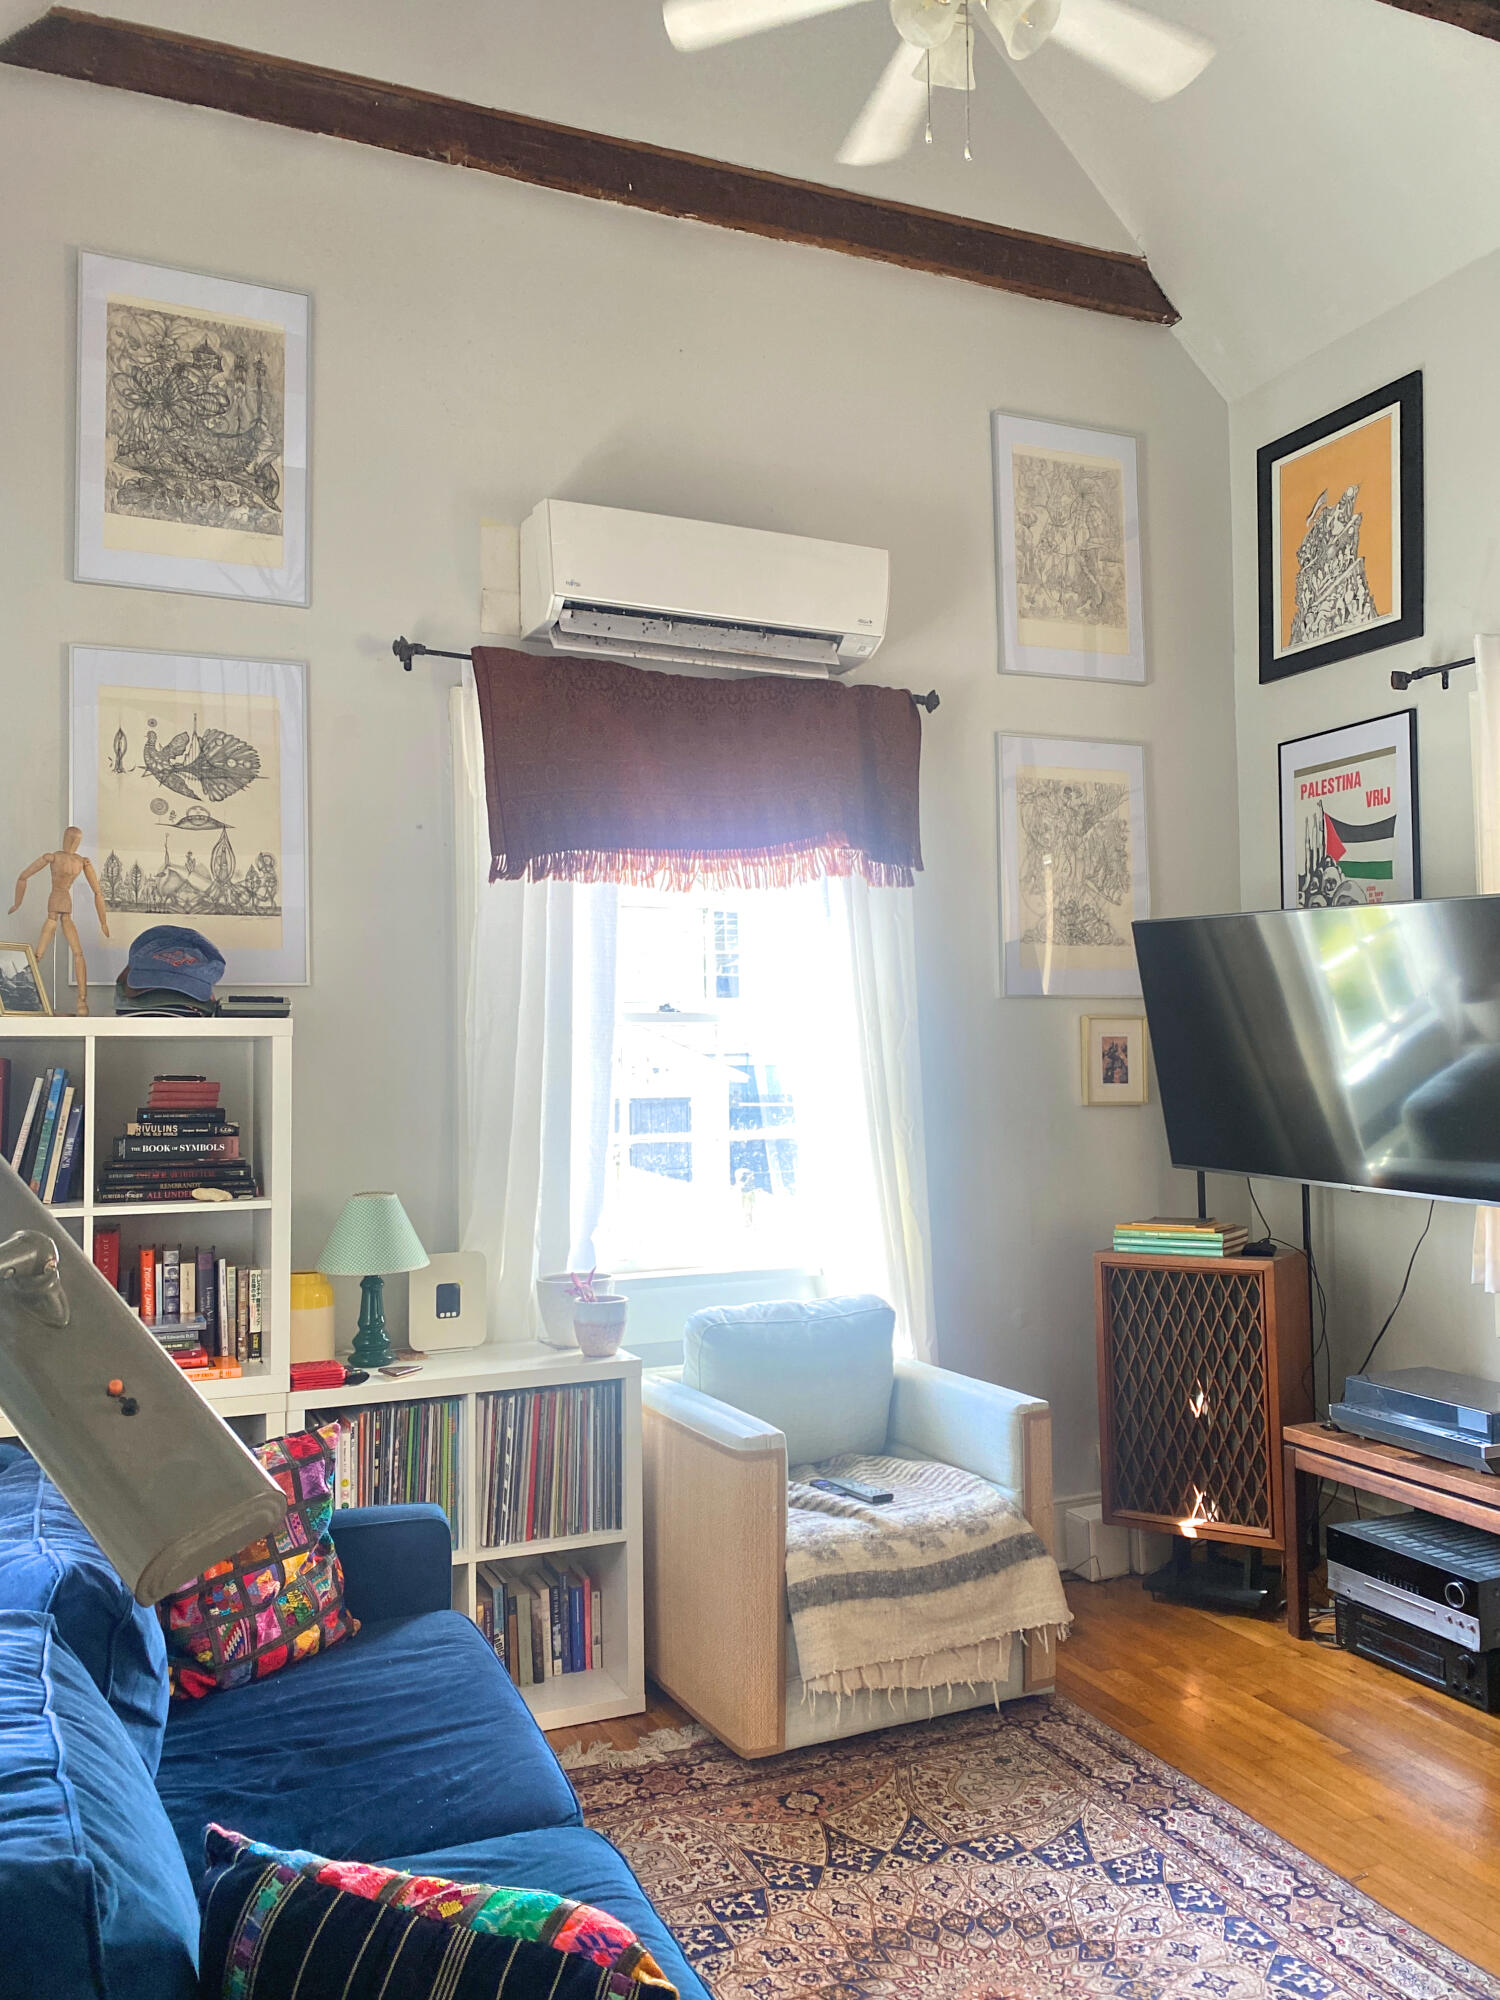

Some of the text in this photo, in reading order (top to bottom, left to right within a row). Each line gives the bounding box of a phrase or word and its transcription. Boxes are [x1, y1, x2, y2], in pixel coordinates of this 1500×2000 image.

[1300, 771, 1362, 800] PALESTINA
[1366, 787, 1391, 808] VRIJ
[136, 1125, 178, 1133] RIVULINS
[142, 1144, 171, 1153] BOOK
[179, 1143, 225, 1152] SYMBOLS
[159, 1182, 202, 1190] REMBRANDT
[147, 1191, 163, 1199] ALL
